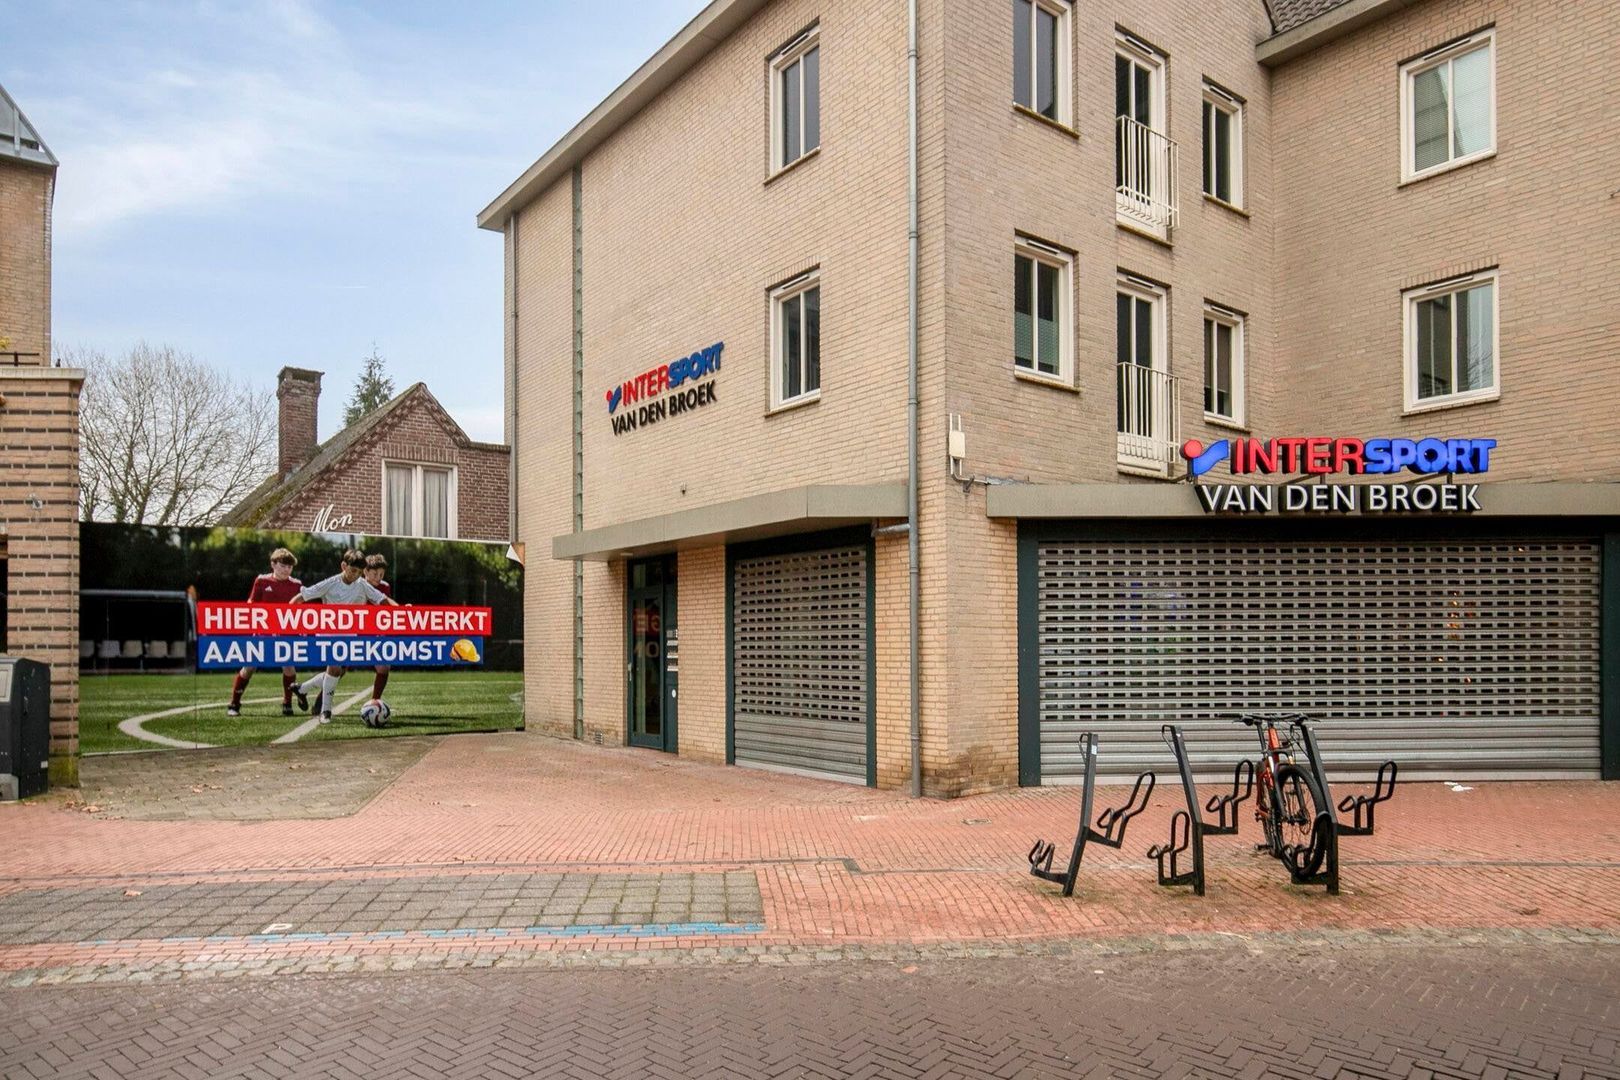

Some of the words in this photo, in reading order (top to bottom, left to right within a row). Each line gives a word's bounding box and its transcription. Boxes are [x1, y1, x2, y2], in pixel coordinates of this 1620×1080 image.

[622, 341, 725, 407] INTERSPORT
[611, 409, 637, 436] VAN
[639, 398, 667, 427] DEN
[669, 379, 717, 416] BROEK
[1232, 436, 1497, 474] INTERSPORT
[1198, 484, 1272, 512] VAN
[1284, 484, 1355, 512] DEN
[1367, 484, 1482, 512] BROEK
[310, 503, 353, 532] Mon
[205, 607, 269, 630] HIER
[276, 608, 369, 631] WORDT
[376, 609, 488, 631] GEWERKT
[203, 641, 265, 664] AAN
[274, 641, 308, 662] DE
[316, 640, 447, 662] TOEKOMST
[261, 923, 293, 934] P
